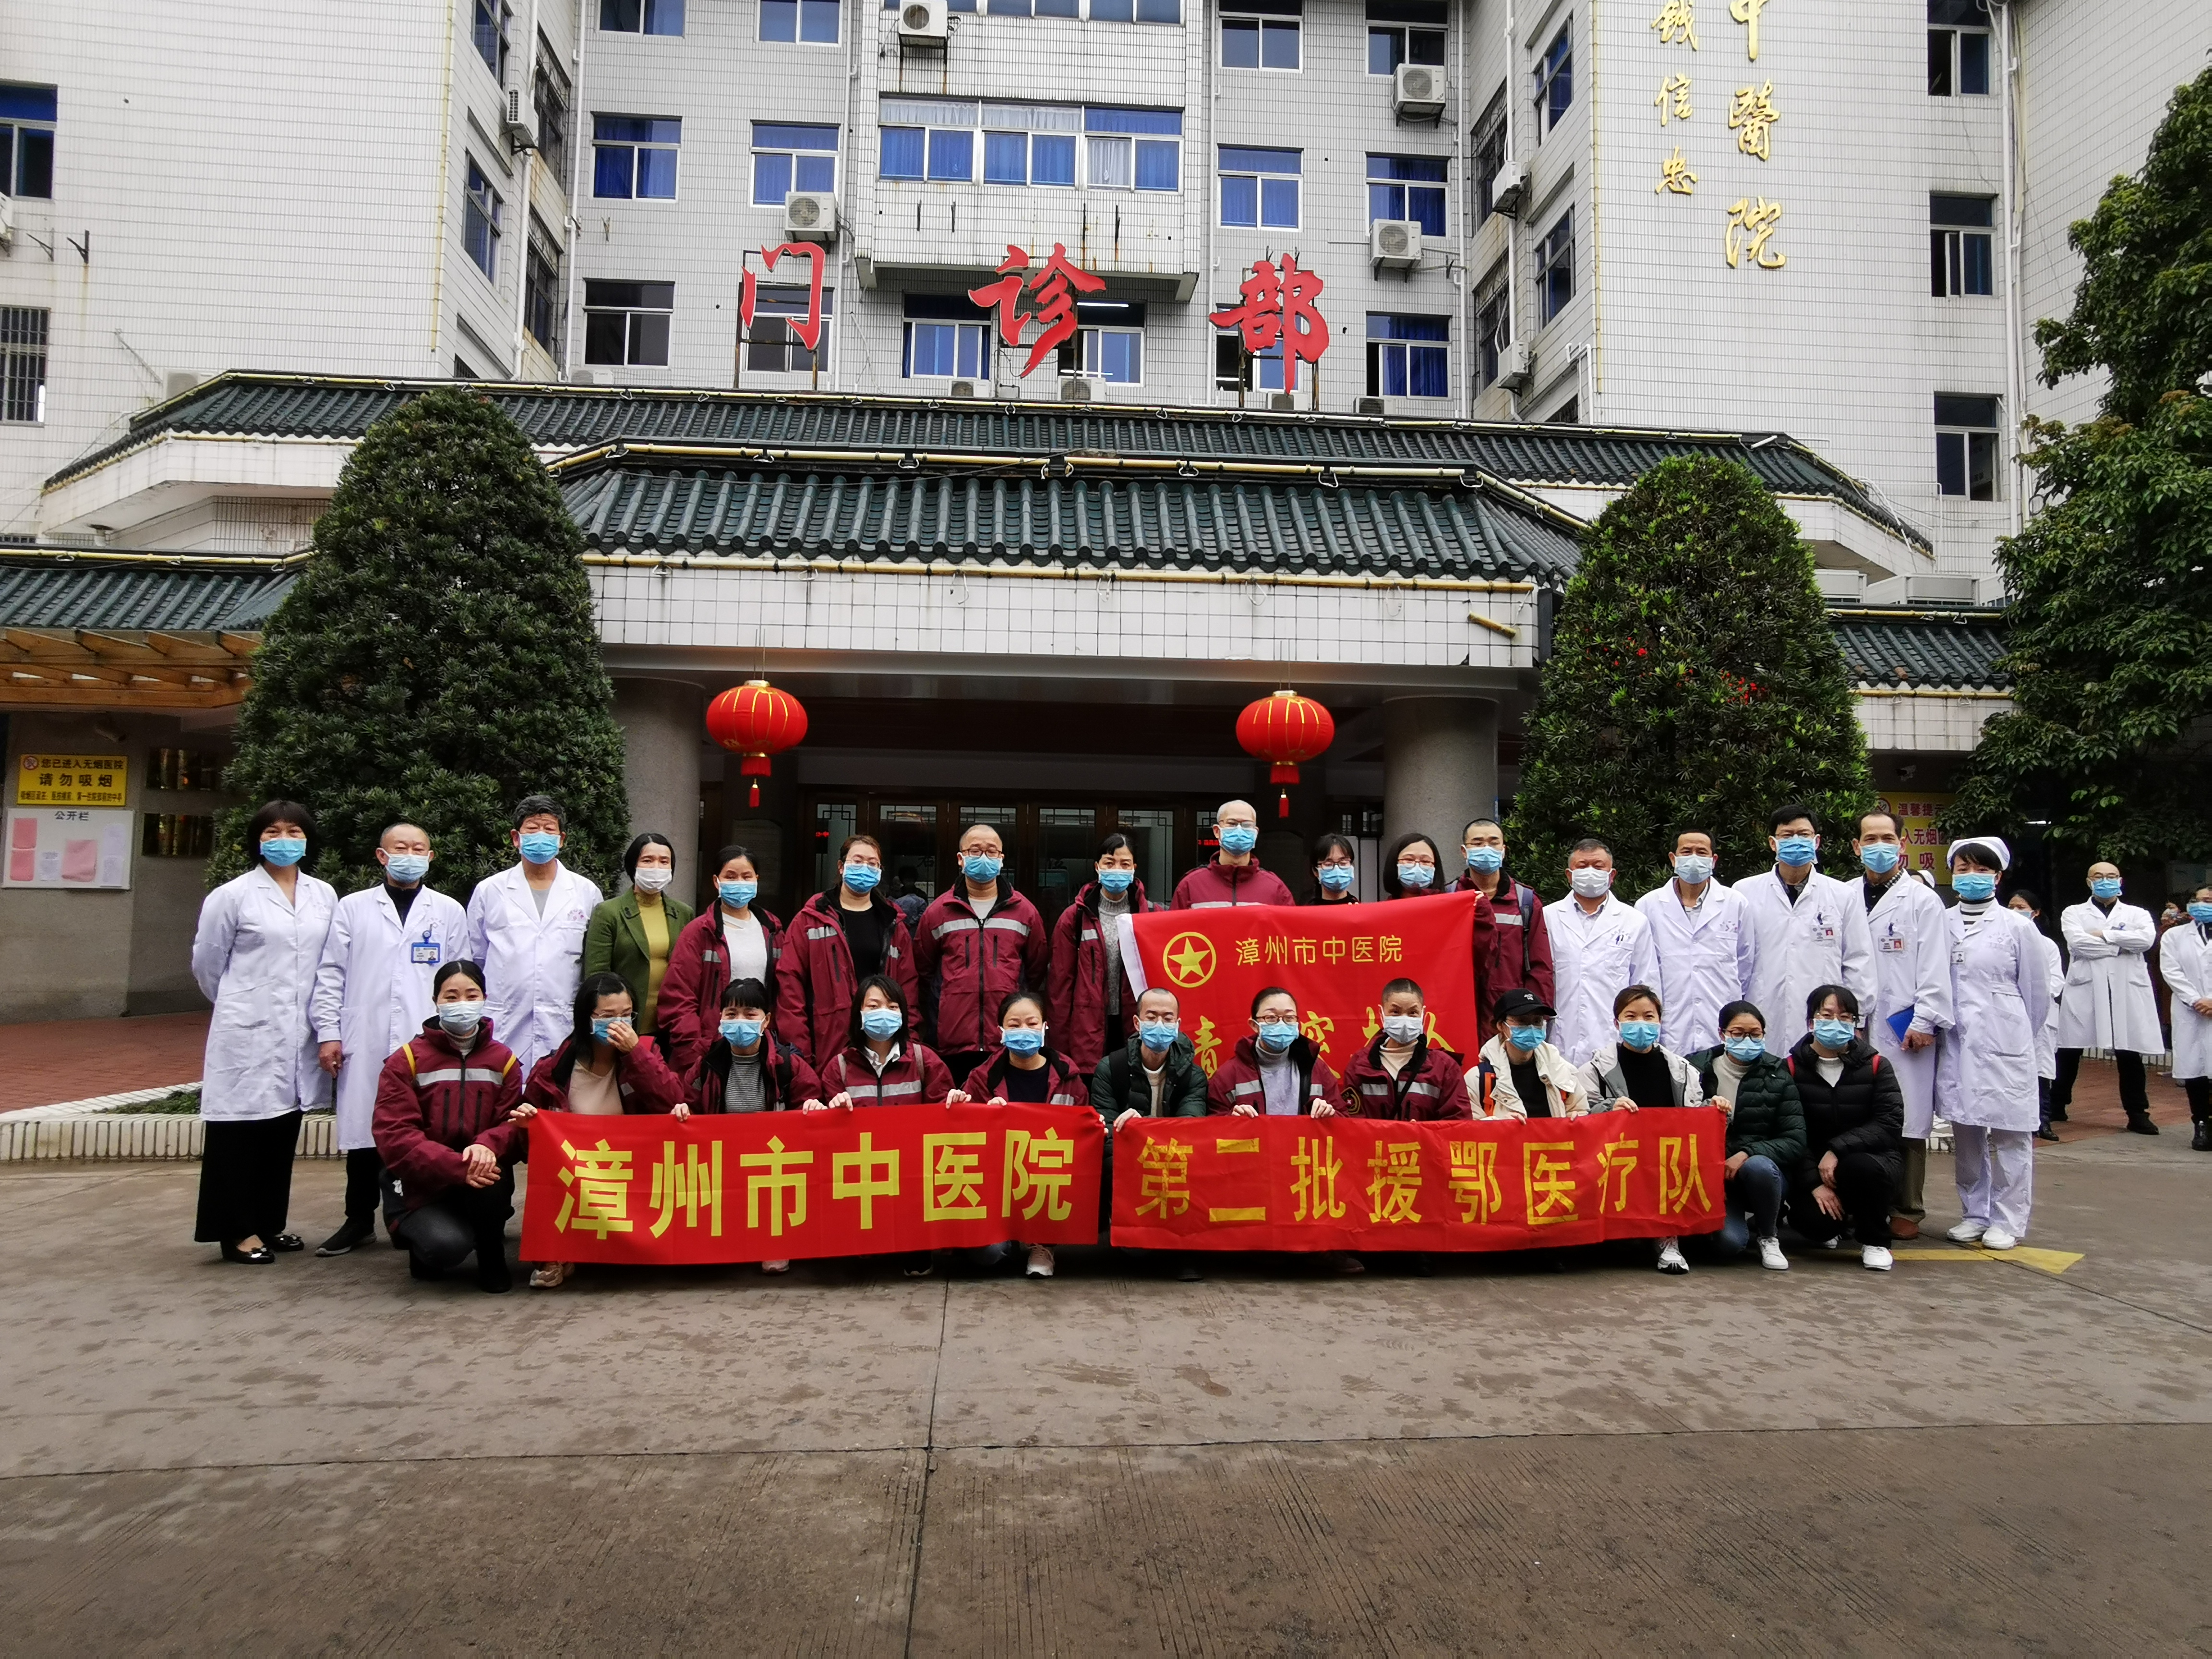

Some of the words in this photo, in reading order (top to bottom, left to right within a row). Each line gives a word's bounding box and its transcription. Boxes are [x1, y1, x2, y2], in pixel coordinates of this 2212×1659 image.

[741, 241, 1330, 395] 门诊部
[41, 758, 124, 769] 您已进入无烟医院
[39, 773, 113, 787] 请勿吸烟
[54, 811, 89, 821] 公开栏
[1235, 935, 1403, 966] 漳州市中医院
[555, 1126, 1074, 1239] 漳州市中医院
[1135, 1132, 1711, 1225] 第二批援鄂医疗队
